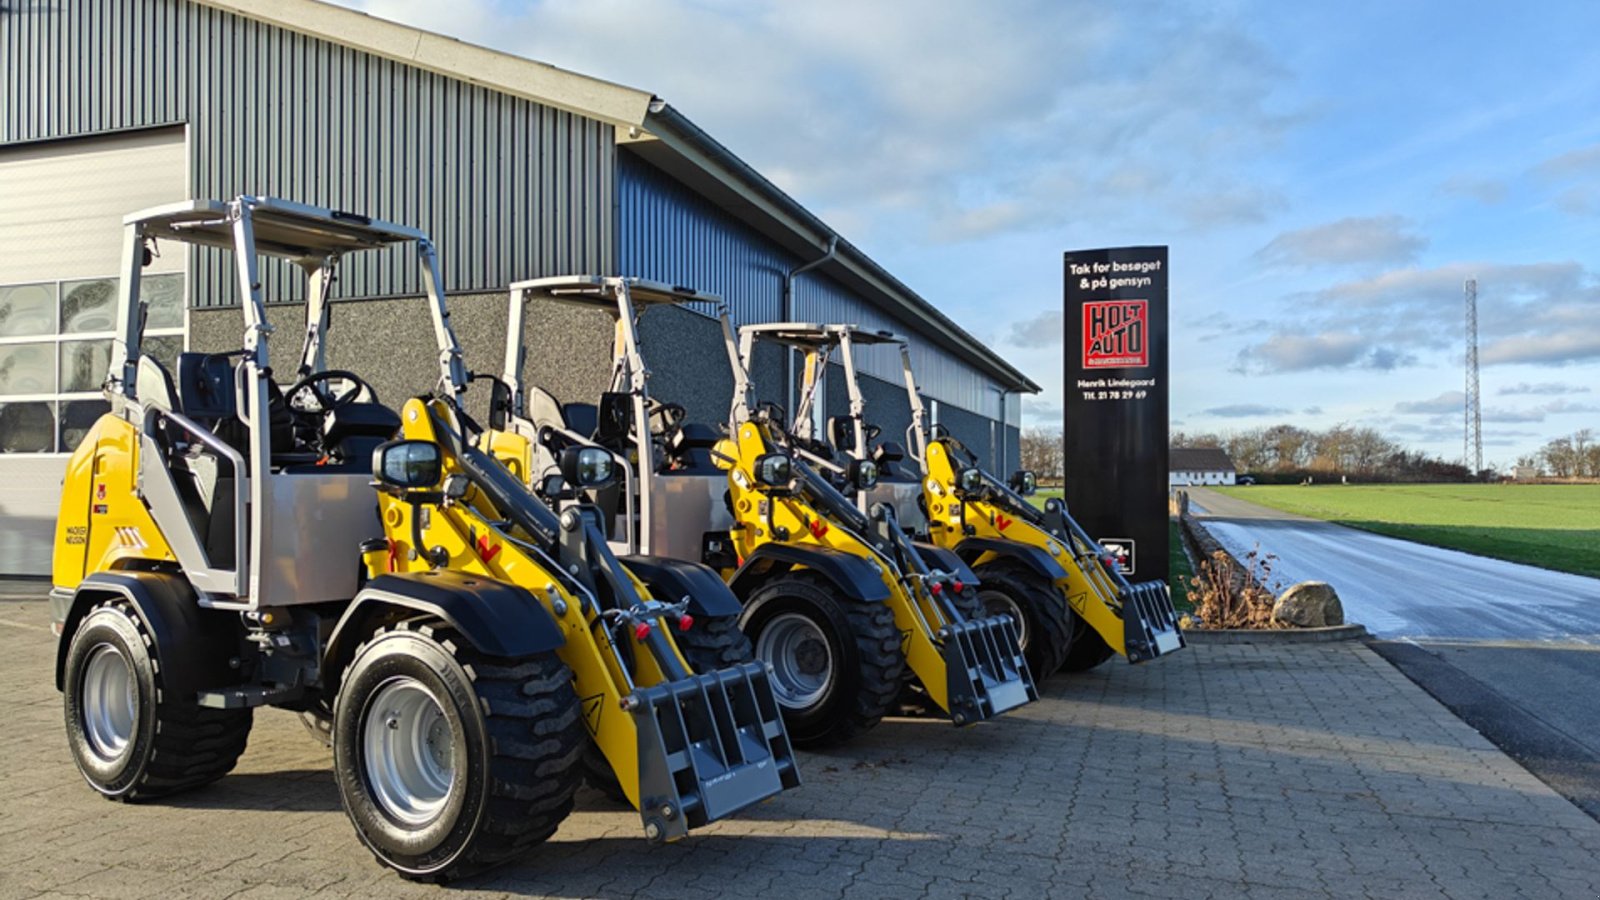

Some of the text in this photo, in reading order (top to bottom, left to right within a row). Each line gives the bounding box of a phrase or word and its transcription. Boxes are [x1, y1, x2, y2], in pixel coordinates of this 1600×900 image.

[1070, 260, 1161, 275] Tak for besøget
[1080, 276, 1151, 291] & på gensyn
[1091, 305, 1141, 338] HOLT
[1089, 320, 1141, 354] AUTO
[1077, 378, 1156, 388] Henrik Lindegaard
[1098, 391, 1108, 400] 21
[1109, 391, 1120, 399] 78
[1122, 390, 1133, 399] 29
[1135, 390, 1147, 399] 69
